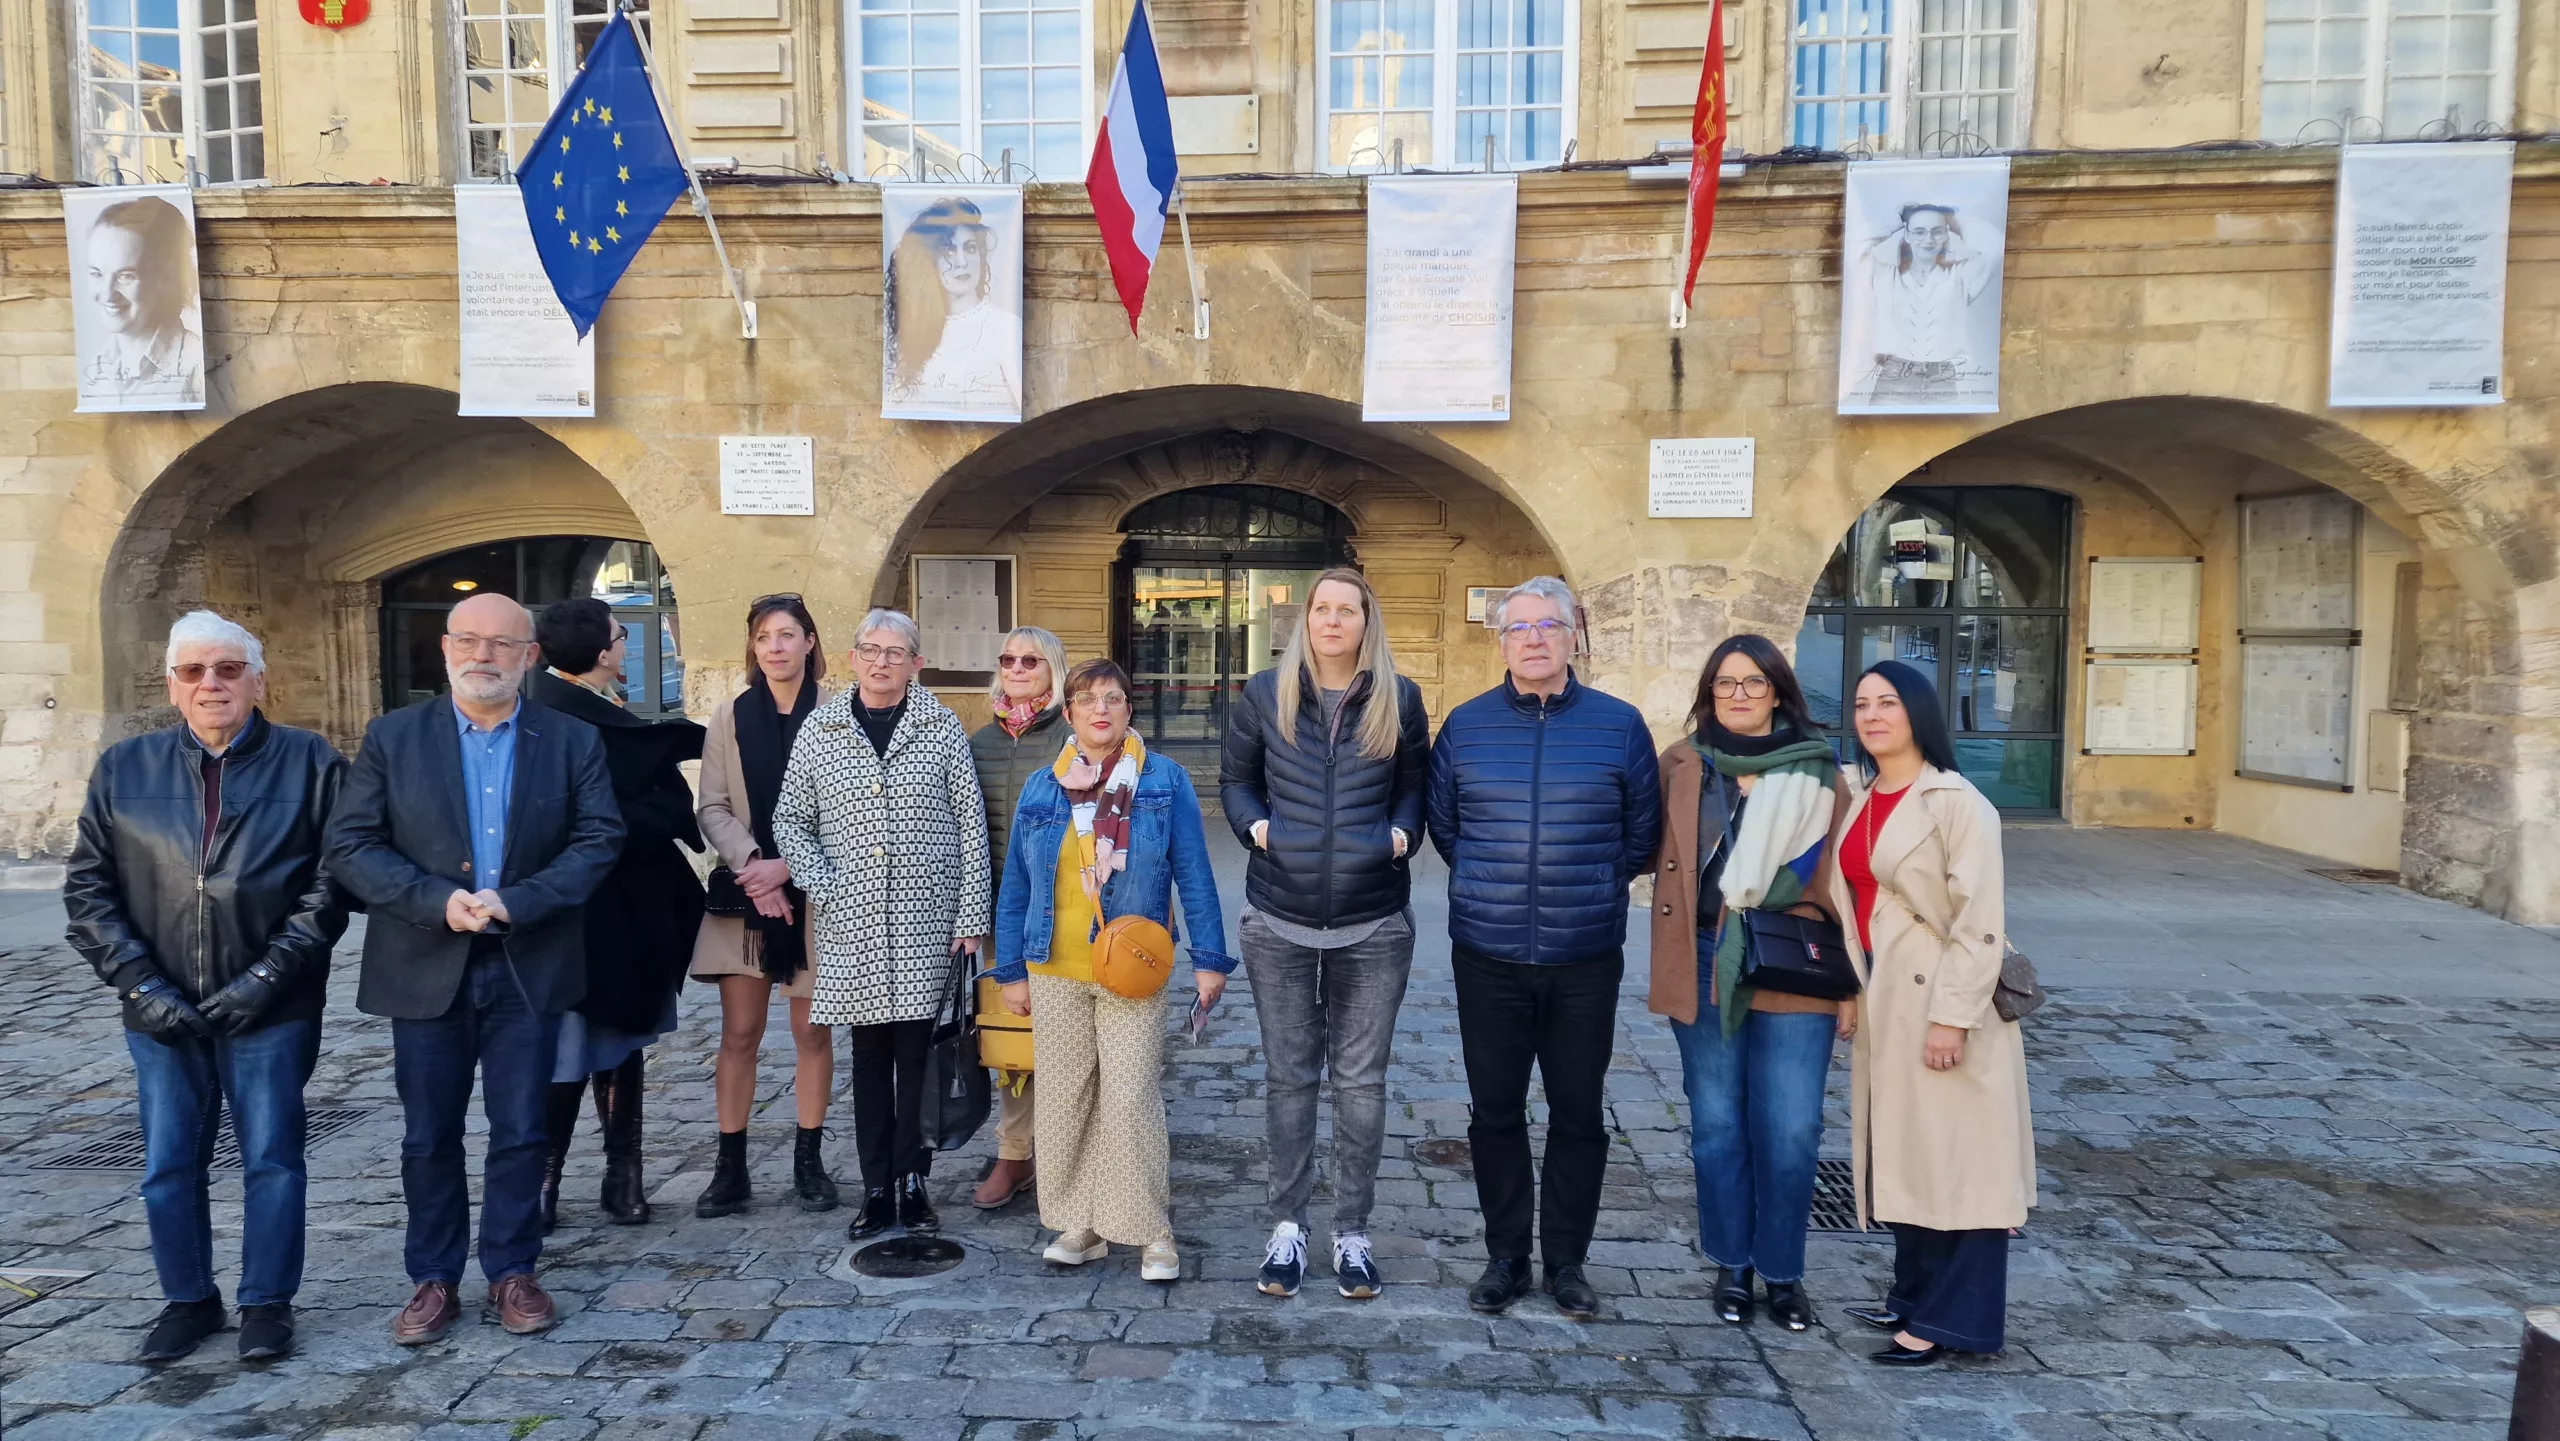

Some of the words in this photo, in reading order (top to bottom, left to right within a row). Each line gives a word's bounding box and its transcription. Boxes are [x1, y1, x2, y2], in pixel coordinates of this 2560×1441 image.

[2356, 224, 2369, 232] Je
[2371, 223, 2392, 231] suis
[2419, 221, 2434, 230] du
[2436, 221, 2464, 230] choix
[2397, 235, 2412, 243] qui
[2445, 233, 2462, 241] fait
[2464, 234, 2489, 242] pour
[1404, 248, 1440, 258] grandi
[1442, 248, 1449, 257] à
[1451, 248, 1473, 257] une
[2354, 247, 2392, 255] arantir
[2418, 245, 2444, 253] droit
[2445, 244, 2460, 253] de
[2394, 257, 2407, 266] de
[2410, 256, 2437, 266] MON
[2439, 256, 2477, 265] CORPS
[471, 271, 484, 280] Je
[485, 271, 505, 280] suis
[1376, 275, 1393, 285] par
[1408, 273, 1421, 283] loi
[1424, 274, 1466, 283] Simone
[2352, 270, 2387, 278] omme
[2387, 269, 2399, 280] je
[465, 283, 498, 293] quand
[2373, 281, 2393, 289] moi
[2395, 281, 2406, 289] et
[2409, 280, 2434, 290] pour
[2437, 280, 2470, 289] toutes
[1417, 287, 1460, 298] laquelle
[2362, 292, 2406, 301] femmes
[2407, 292, 2425, 302] qui
[2427, 292, 2445, 300] me
[466, 295, 515, 304] volontaire
[516, 295, 530, 304] de
[1392, 300, 1432, 309] obtenu
[1434, 300, 1444, 309] le
[1446, 299, 1472, 309] droit
[1489, 299, 1499, 309] la
[466, 307, 489, 317] était
[490, 309, 525, 317] encore
[527, 309, 541, 317] un
[1375, 313, 1429, 323] possibilité
[1431, 312, 1446, 322] de
[1662, 449, 1674, 457] ICI
[1678, 449, 1686, 457] LE
[1723, 448, 1742, 456] 1944
